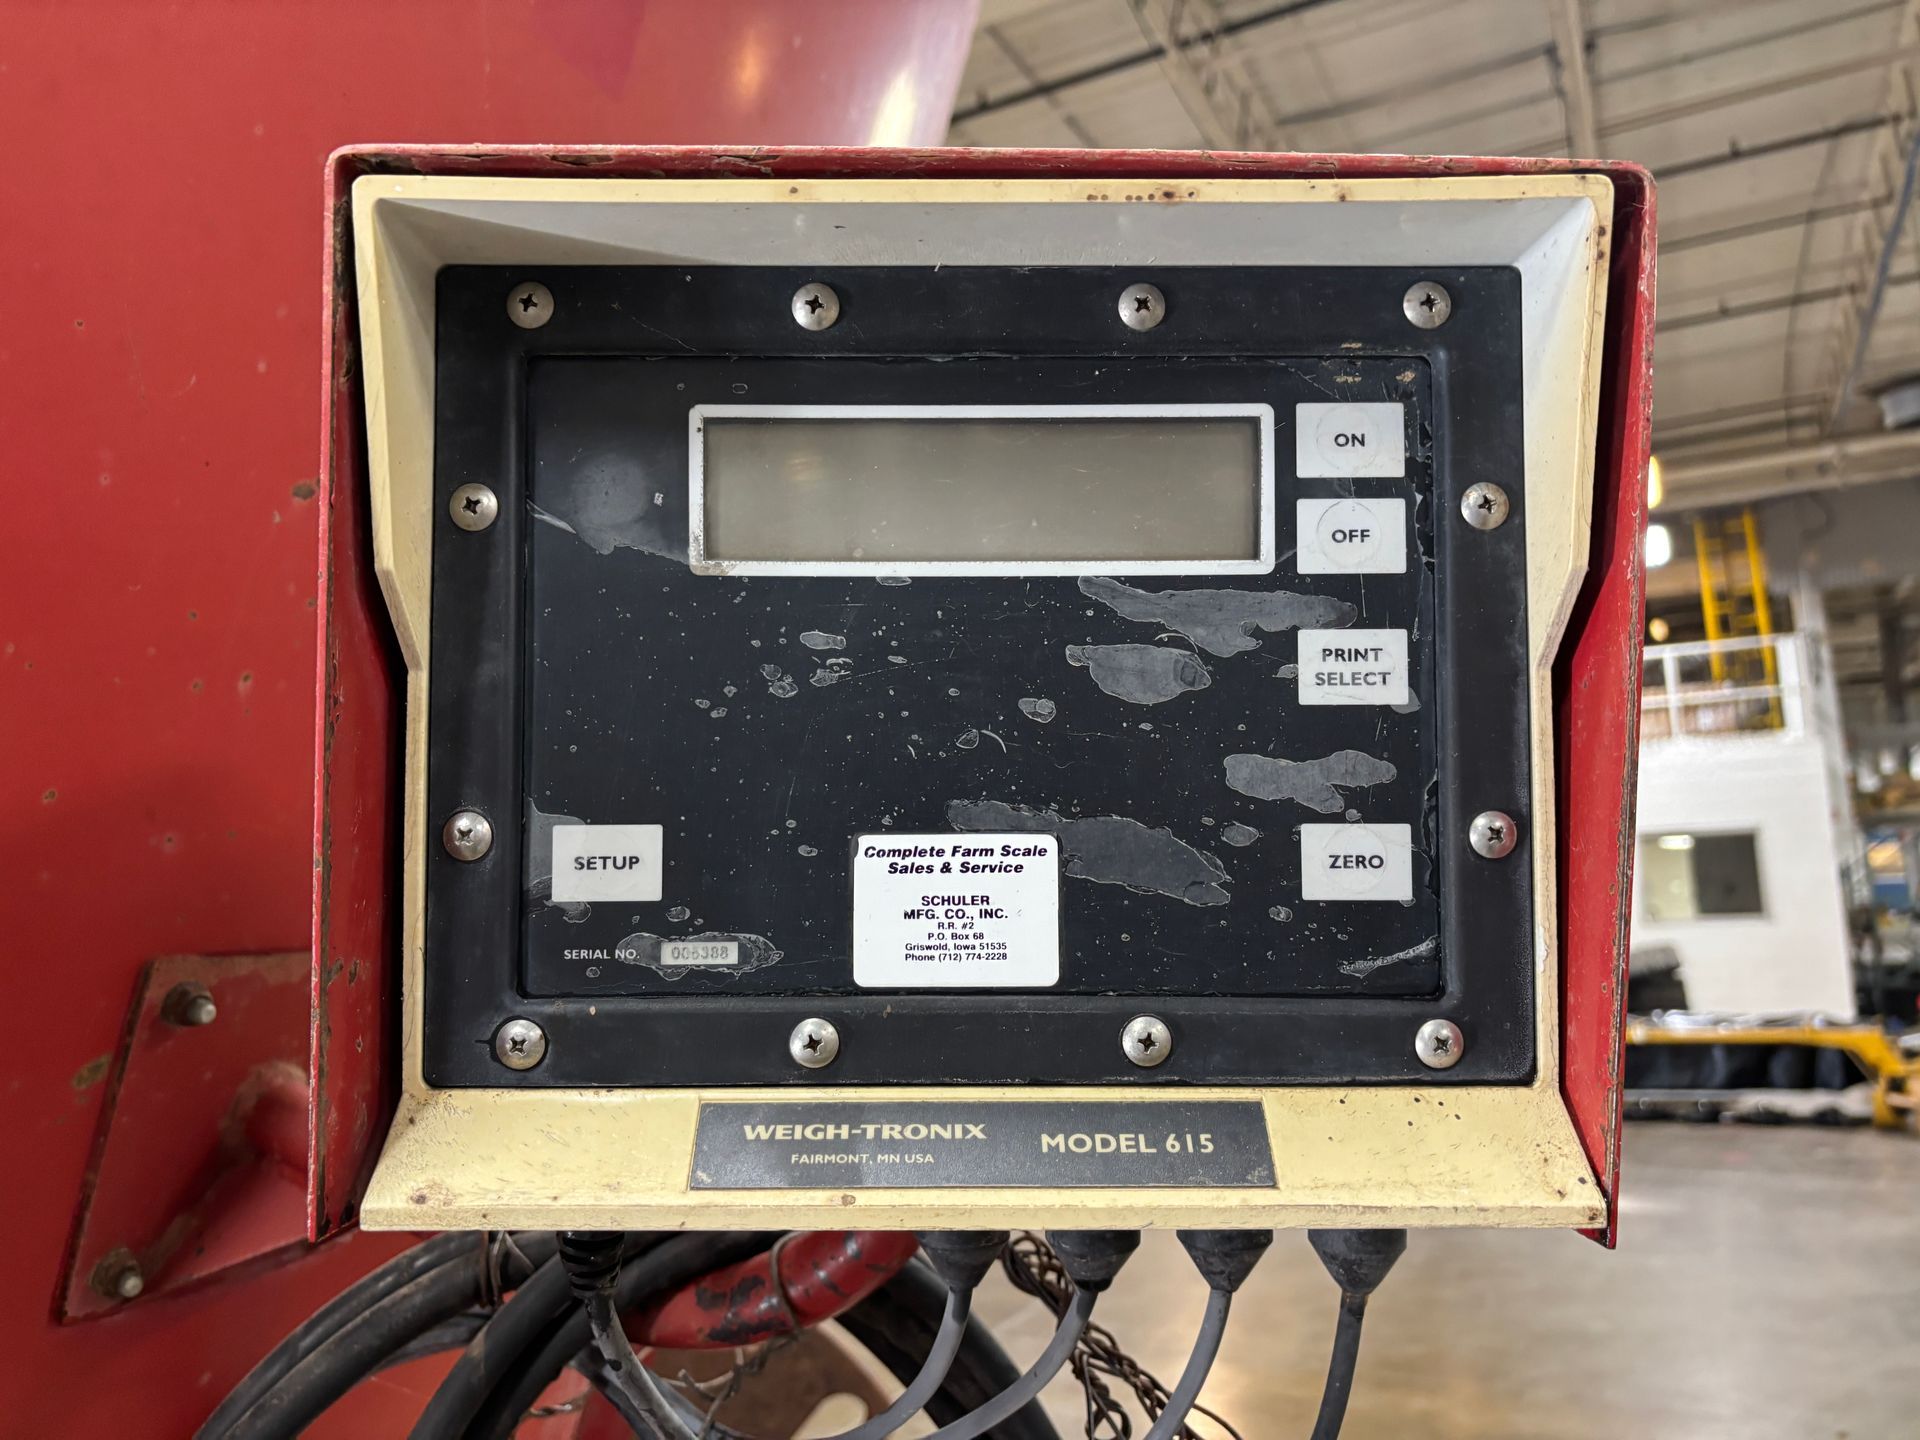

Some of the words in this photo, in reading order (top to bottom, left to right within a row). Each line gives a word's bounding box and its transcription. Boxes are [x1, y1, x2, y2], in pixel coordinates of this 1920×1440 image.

[1334, 433, 1366, 447] ON
[1331, 529, 1371, 543] OFF
[1321, 648, 1383, 662] PRINT
[1314, 672, 1391, 686] SELECT
[864, 845, 945, 860] Complete
[951, 845, 994, 857] Farm
[1000, 845, 1048, 857] Scale
[574, 855, 640, 870] SETUP
[888, 862, 934, 874] Sales
[940, 861, 952, 874] &
[959, 861, 1024, 873] Service
[1328, 854, 1385, 869] ZERO
[921, 895, 990, 906] SCHULER
[903, 908, 940, 920] MFG.
[944, 908, 974, 921] CO.,
[979, 908, 1008, 919] INC.
[937, 921, 957, 930] R.R.
[961, 921, 974, 930] #2
[928, 932, 947, 940] P.O.
[951, 932, 969, 940] Box
[973, 932, 984, 940] 68
[905, 942, 950, 952] Griswold,
[954, 942, 976, 951] Iowa
[979, 942, 1007, 951] 51535
[564, 949, 610, 960] SERIAL
[615, 949, 640, 960] NO.
[905, 953, 935, 961] Phone
[938, 953, 962, 962] (712)
[965, 952, 1007, 961] 774-2228
[743, 1123, 988, 1140] WEIGH-TRONIX
[1041, 1133, 1157, 1153] MODEL
[1165, 1133, 1215, 1153] 615
[791, 1153, 873, 1164] FAIRMONT,
[877, 1153, 900, 1163] MN
[905, 1153, 935, 1163] USA
